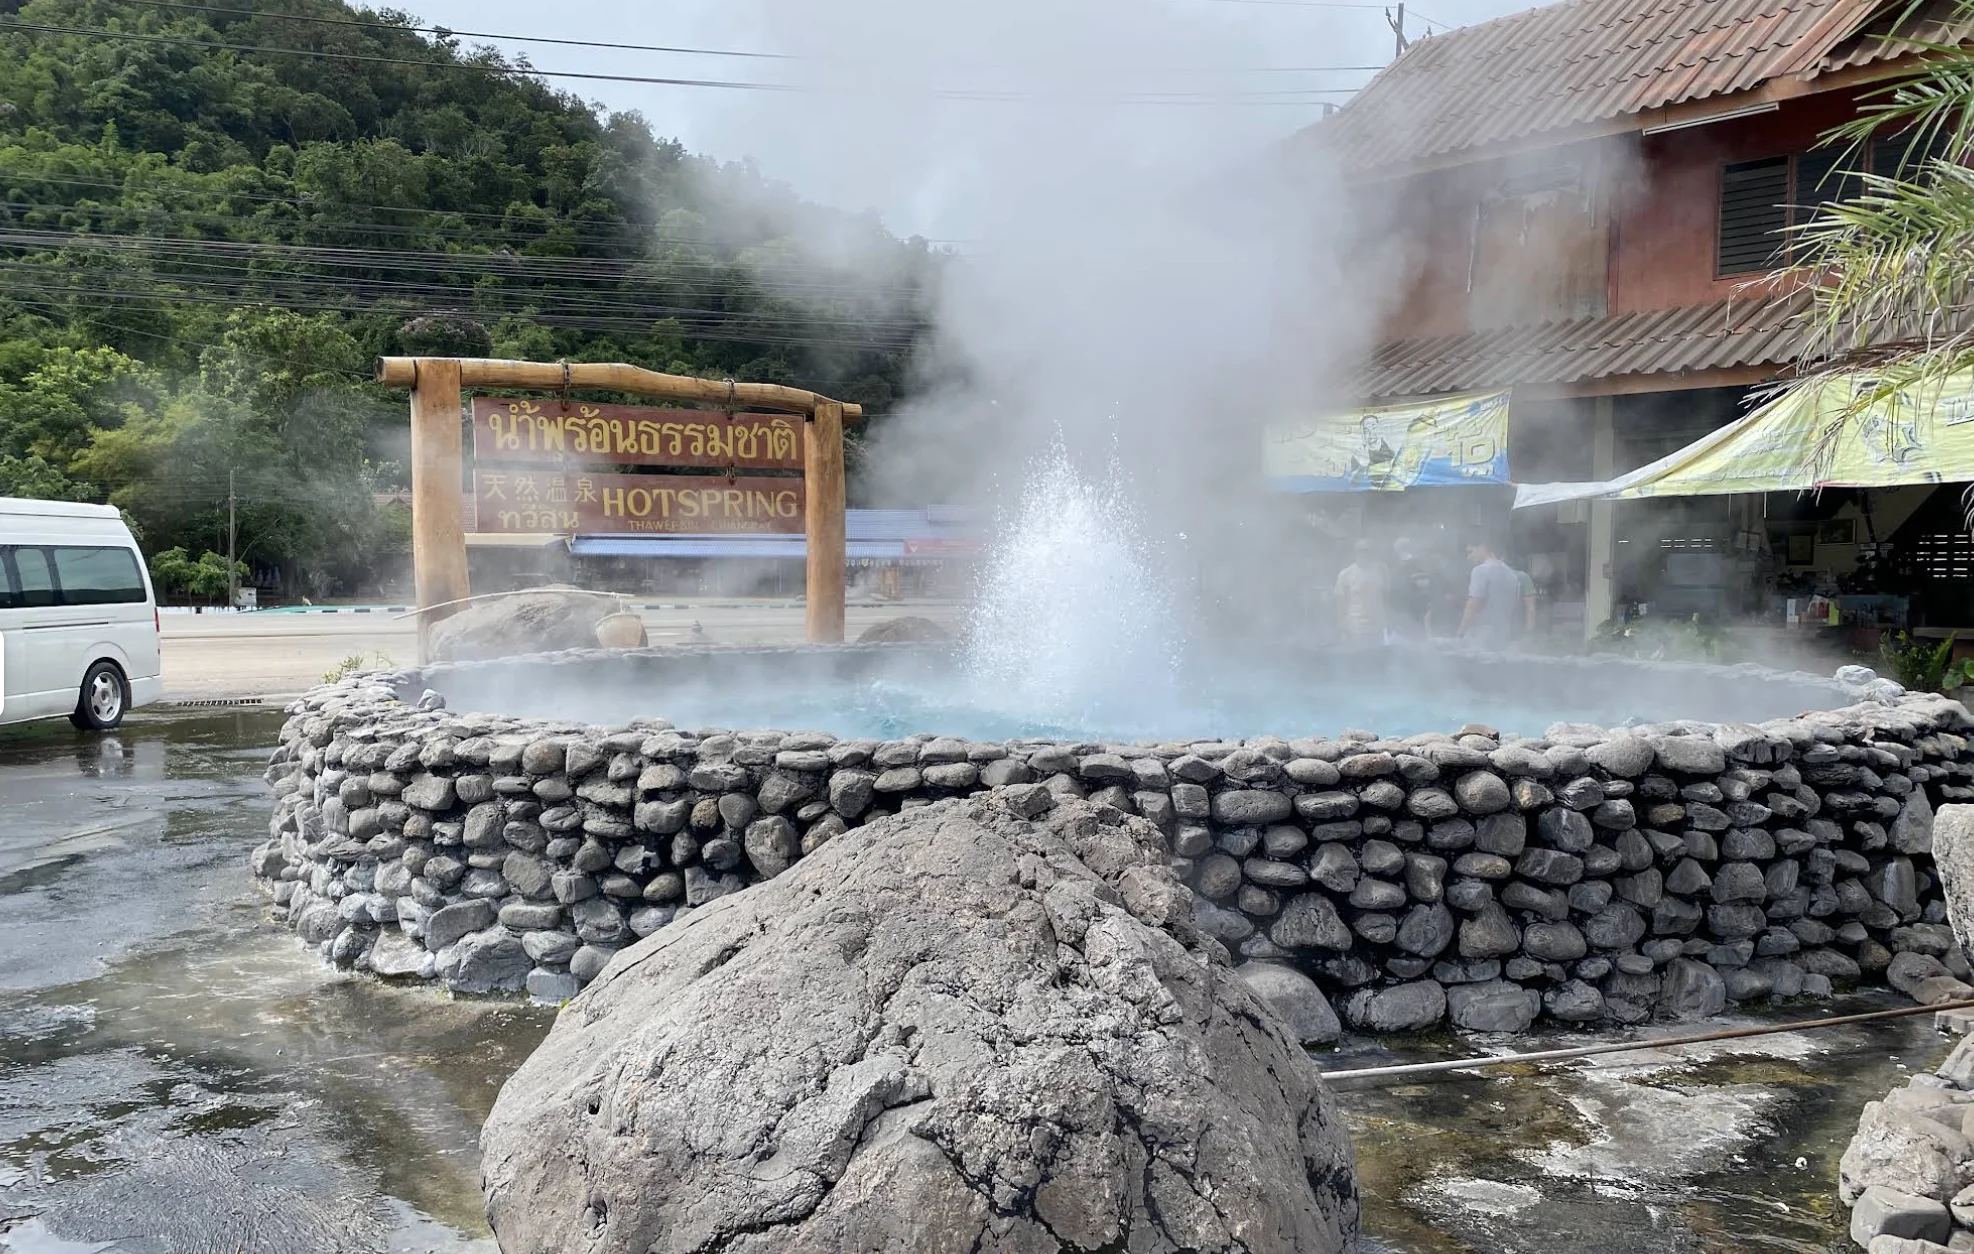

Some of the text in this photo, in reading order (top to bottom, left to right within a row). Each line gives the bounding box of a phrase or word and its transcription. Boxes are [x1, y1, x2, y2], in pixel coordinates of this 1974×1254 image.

[489, 401, 797, 461] น้ำพุร้อนธรรมชาติ
[603, 488, 798, 517] HOTSPRING
